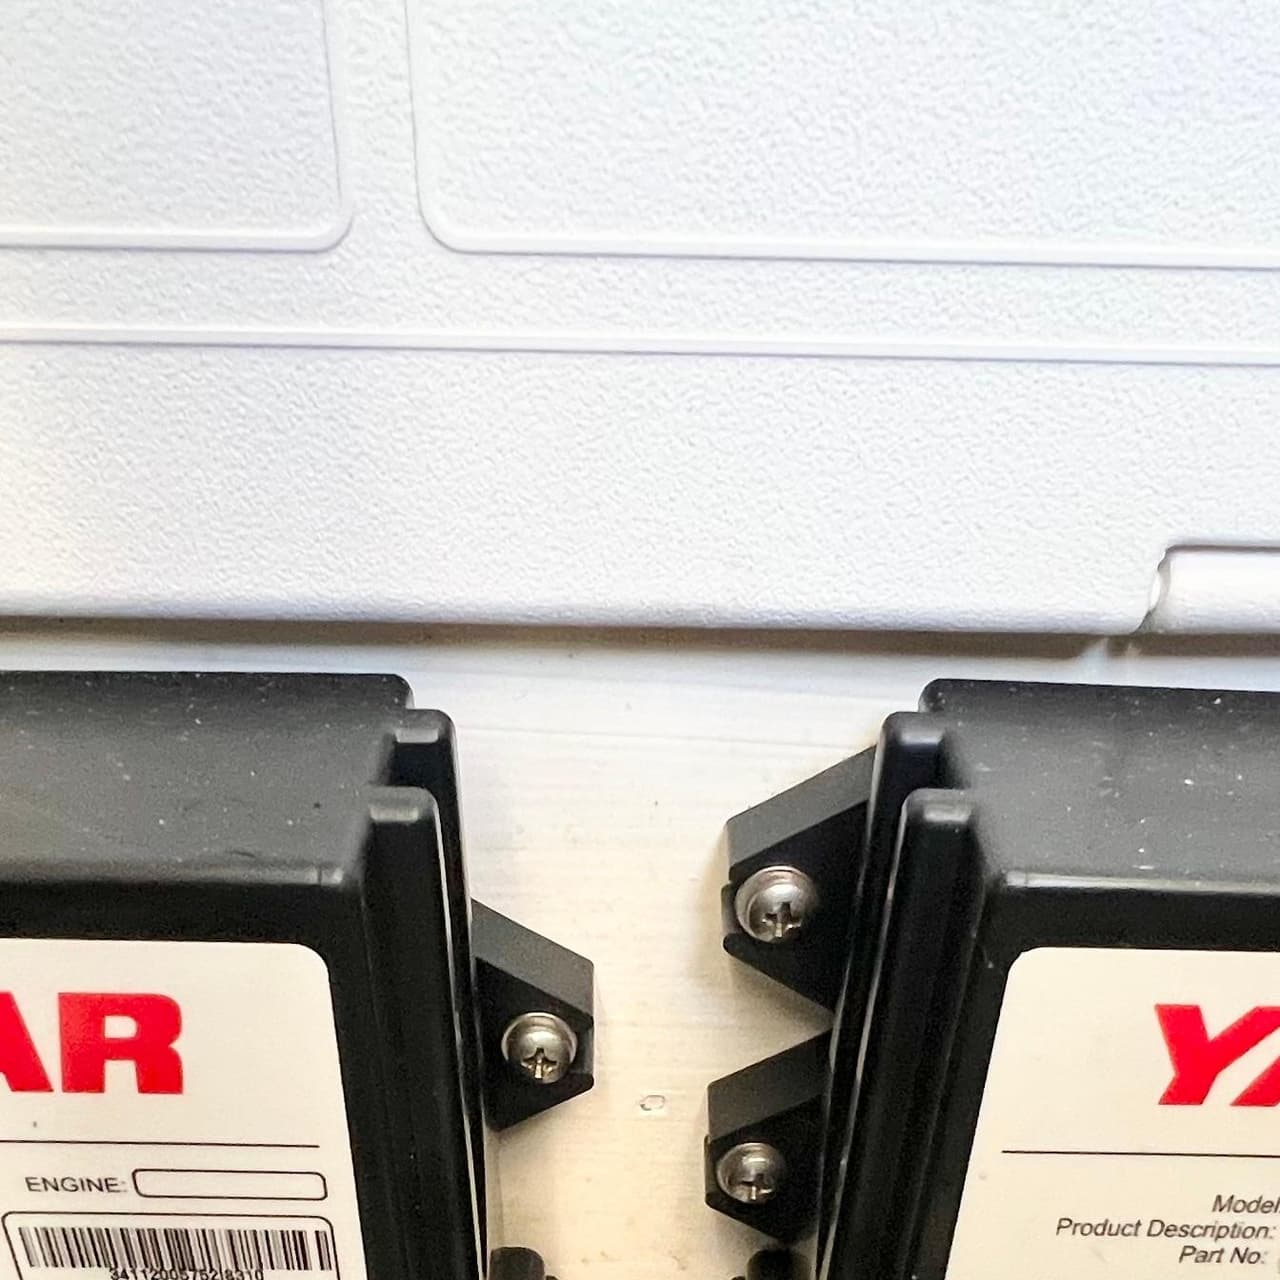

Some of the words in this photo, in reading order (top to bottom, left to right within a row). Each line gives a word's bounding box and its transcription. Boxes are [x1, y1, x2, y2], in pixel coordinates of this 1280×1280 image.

[24, 1176, 128, 1193] ENGINE:
[1055, 1217, 1142, 1238] Product
[1146, 1218, 1277, 1242] Description:
[1178, 1245, 1225, 1264] Part
[1229, 1247, 1268, 1265] No:
